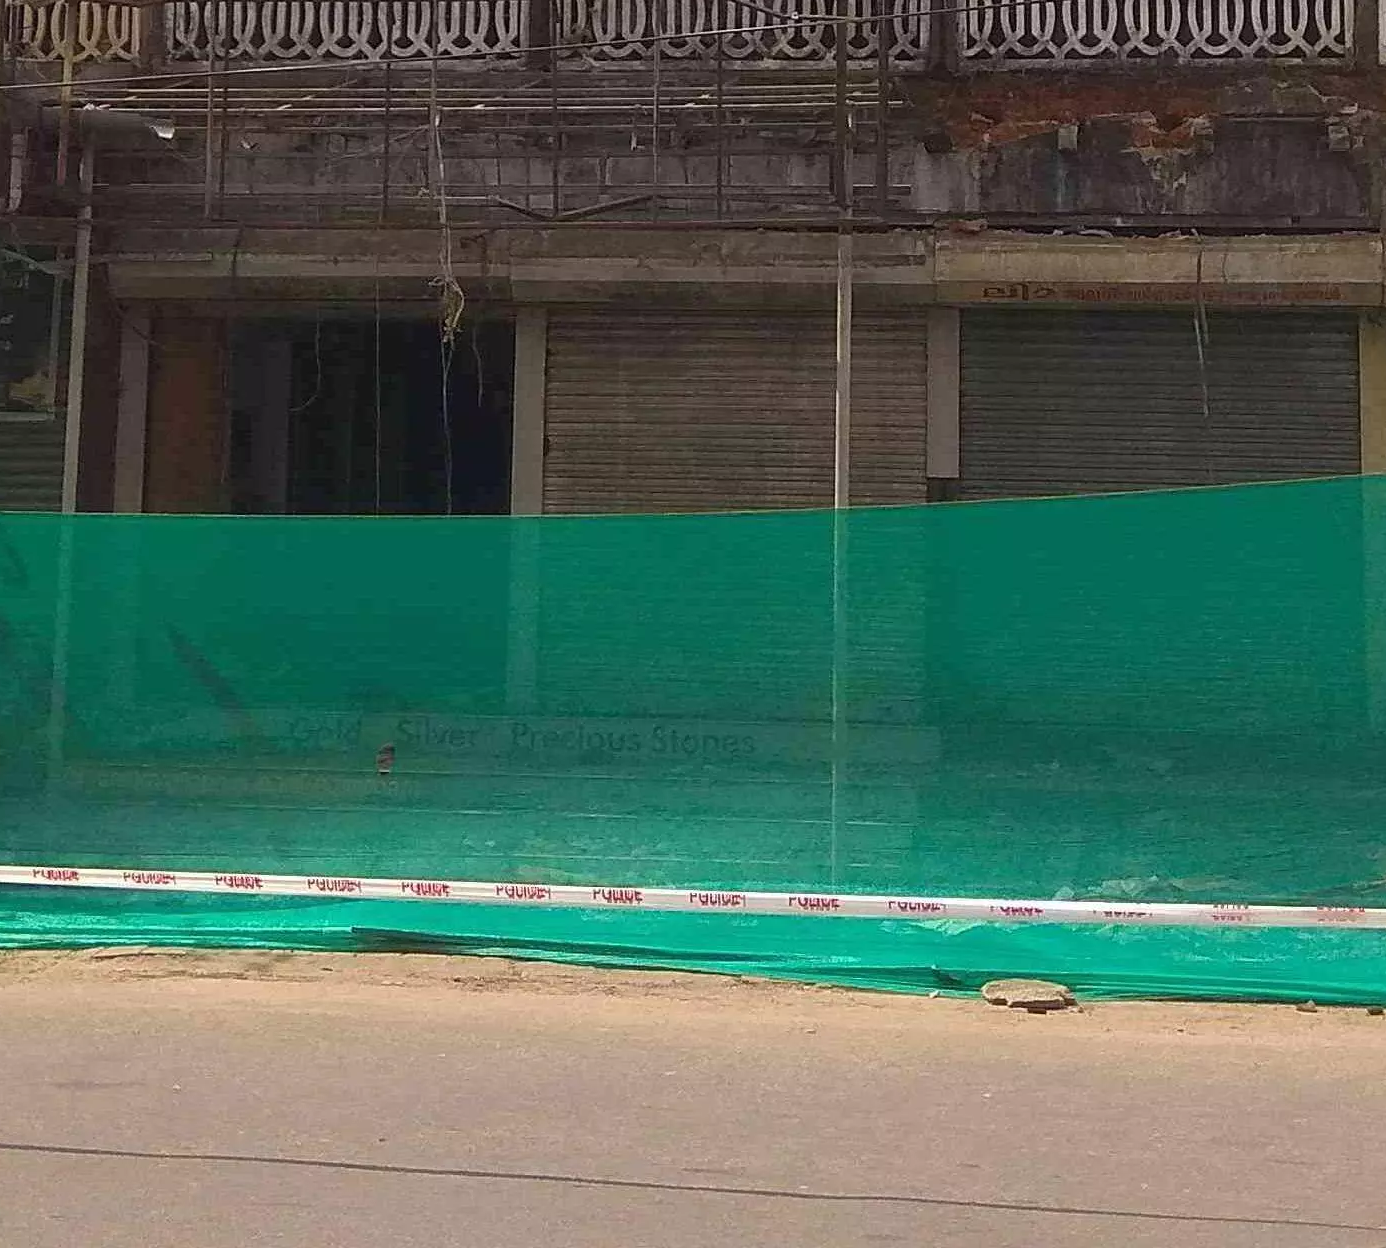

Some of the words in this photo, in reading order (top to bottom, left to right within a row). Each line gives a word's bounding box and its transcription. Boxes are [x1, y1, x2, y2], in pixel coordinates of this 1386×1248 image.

[396, 719, 480, 748] Silver
[511, 723, 641, 754] Precious
[652, 725, 757, 756] Stones
